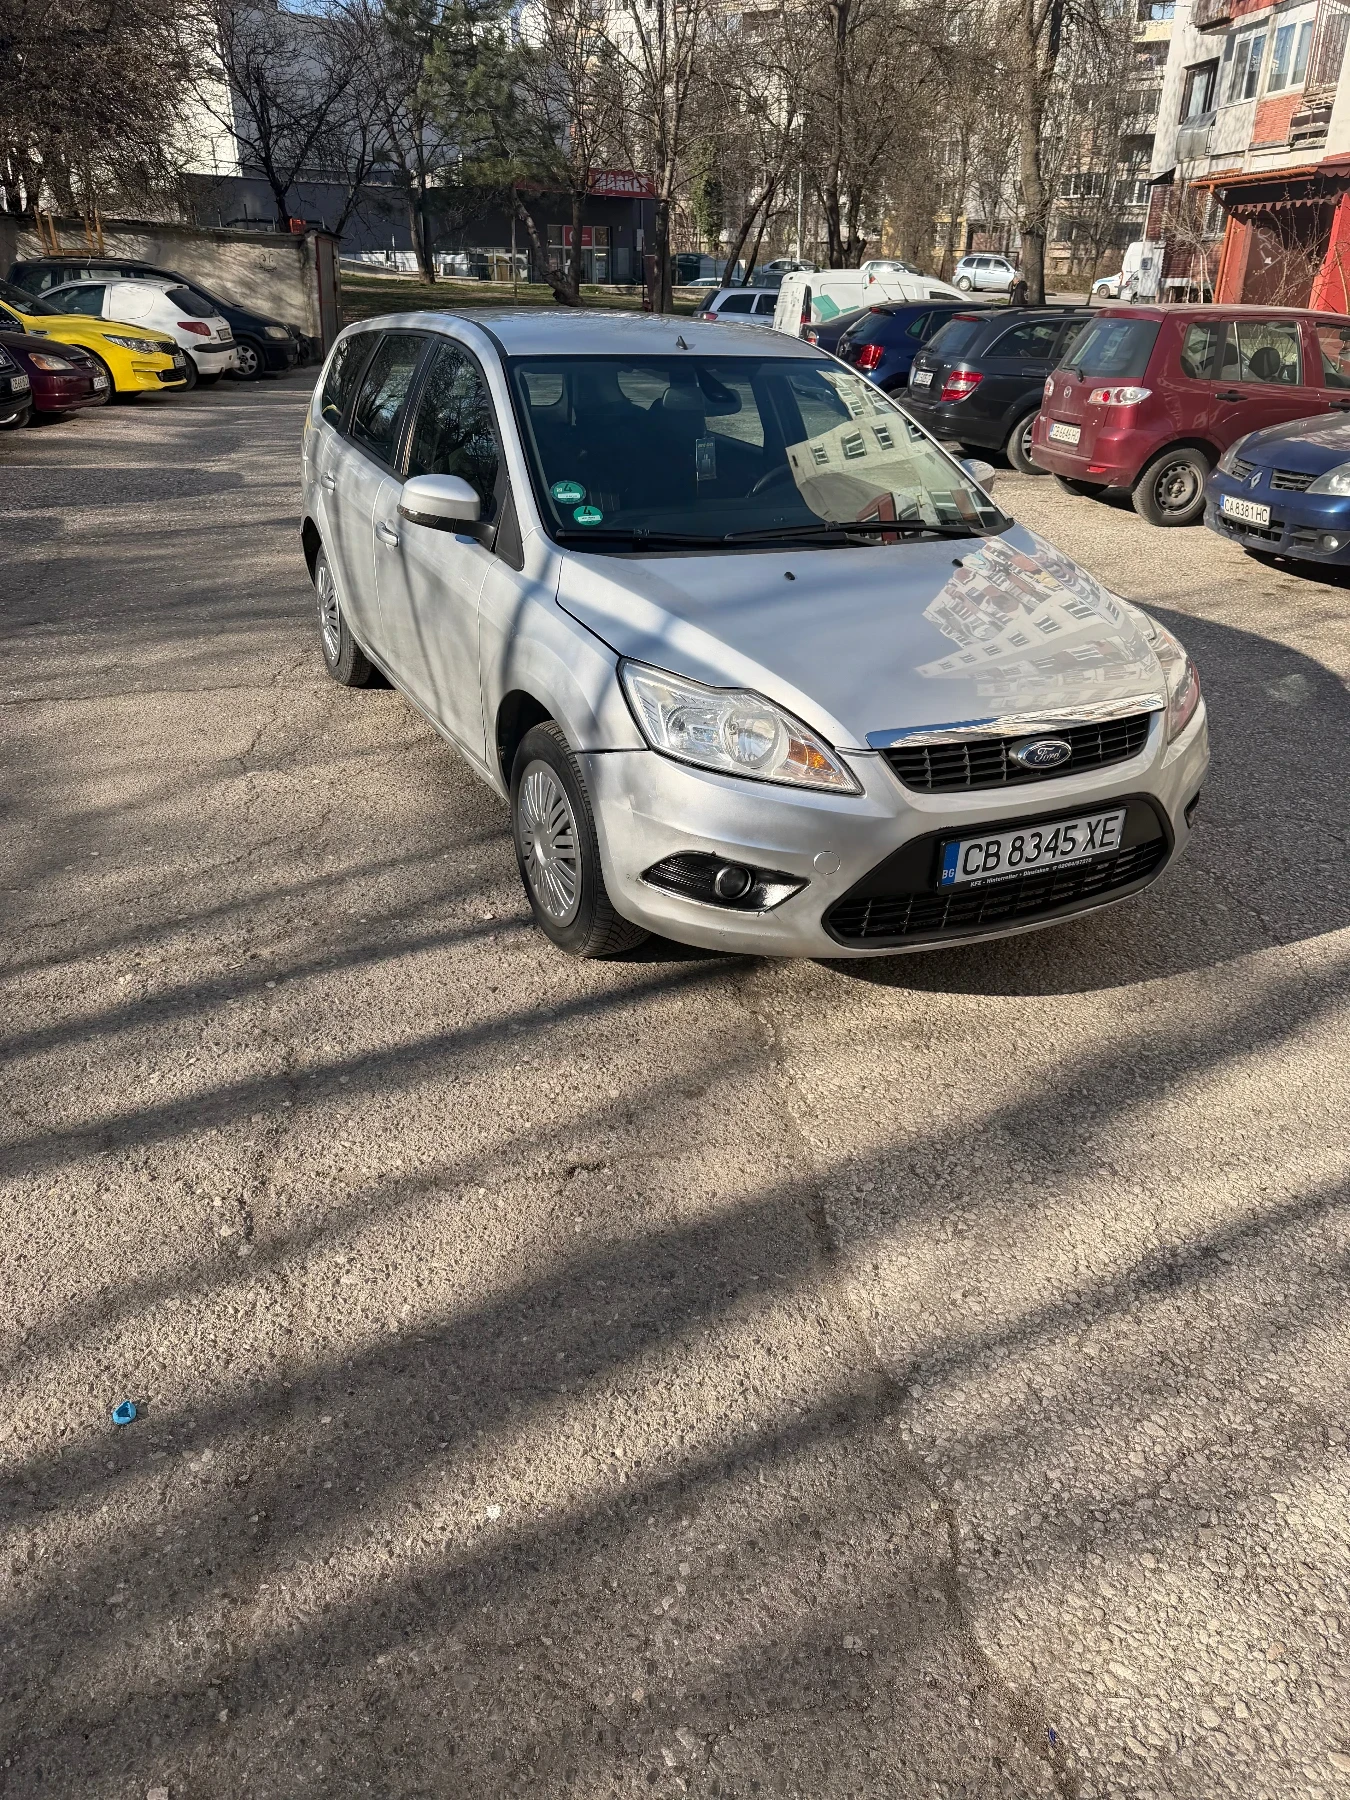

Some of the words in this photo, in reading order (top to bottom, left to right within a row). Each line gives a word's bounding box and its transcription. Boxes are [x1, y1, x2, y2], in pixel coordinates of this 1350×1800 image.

[594, 173, 648, 193] MARKET
[564, 483, 573, 492] 4
[583, 506, 592, 515] 4
[1224, 498, 1234, 513] CA
[1235, 502, 1254, 519] 8381
[1255, 507, 1268, 523] HC
[1034, 746, 1062, 762] Ford
[962, 839, 1002, 876] CB
[1007, 823, 1079, 867] 8345
[1081, 815, 1120, 852] XE
[941, 868, 955, 880] BG
